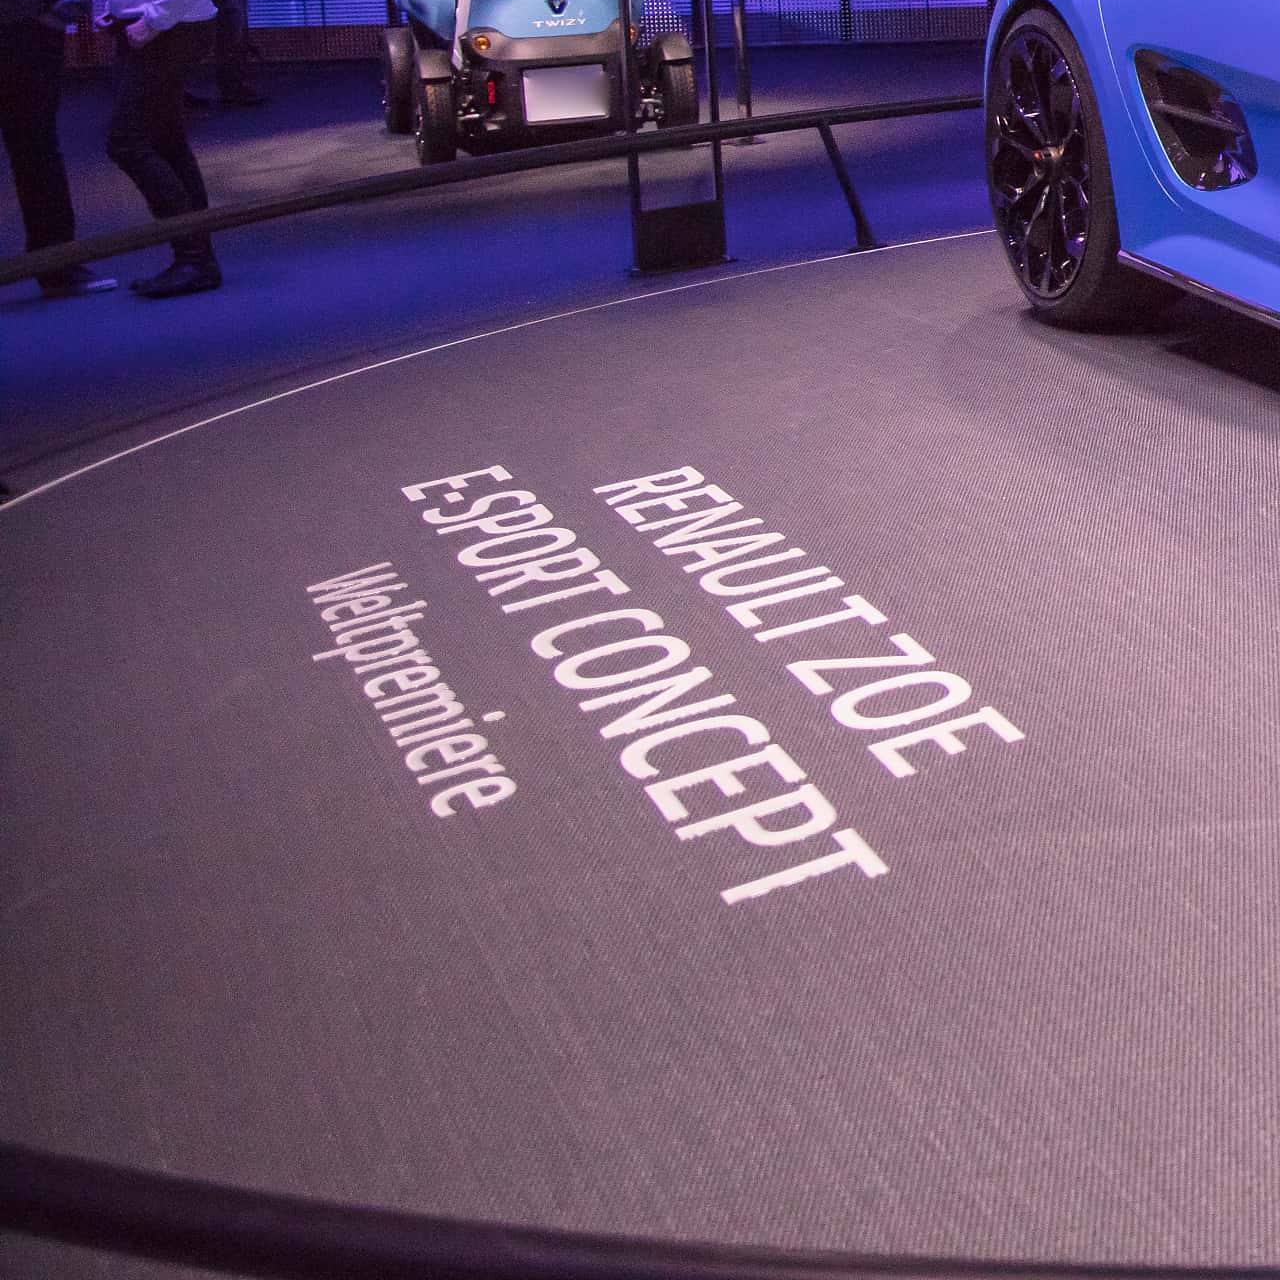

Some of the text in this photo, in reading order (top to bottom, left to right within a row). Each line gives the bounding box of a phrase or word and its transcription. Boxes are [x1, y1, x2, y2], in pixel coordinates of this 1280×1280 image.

[532, 18, 586, 28] TWIZY
[401, 464, 890, 905] E-SPORT CONCEPT
[593, 466, 1026, 778] RENAULT ZOE
